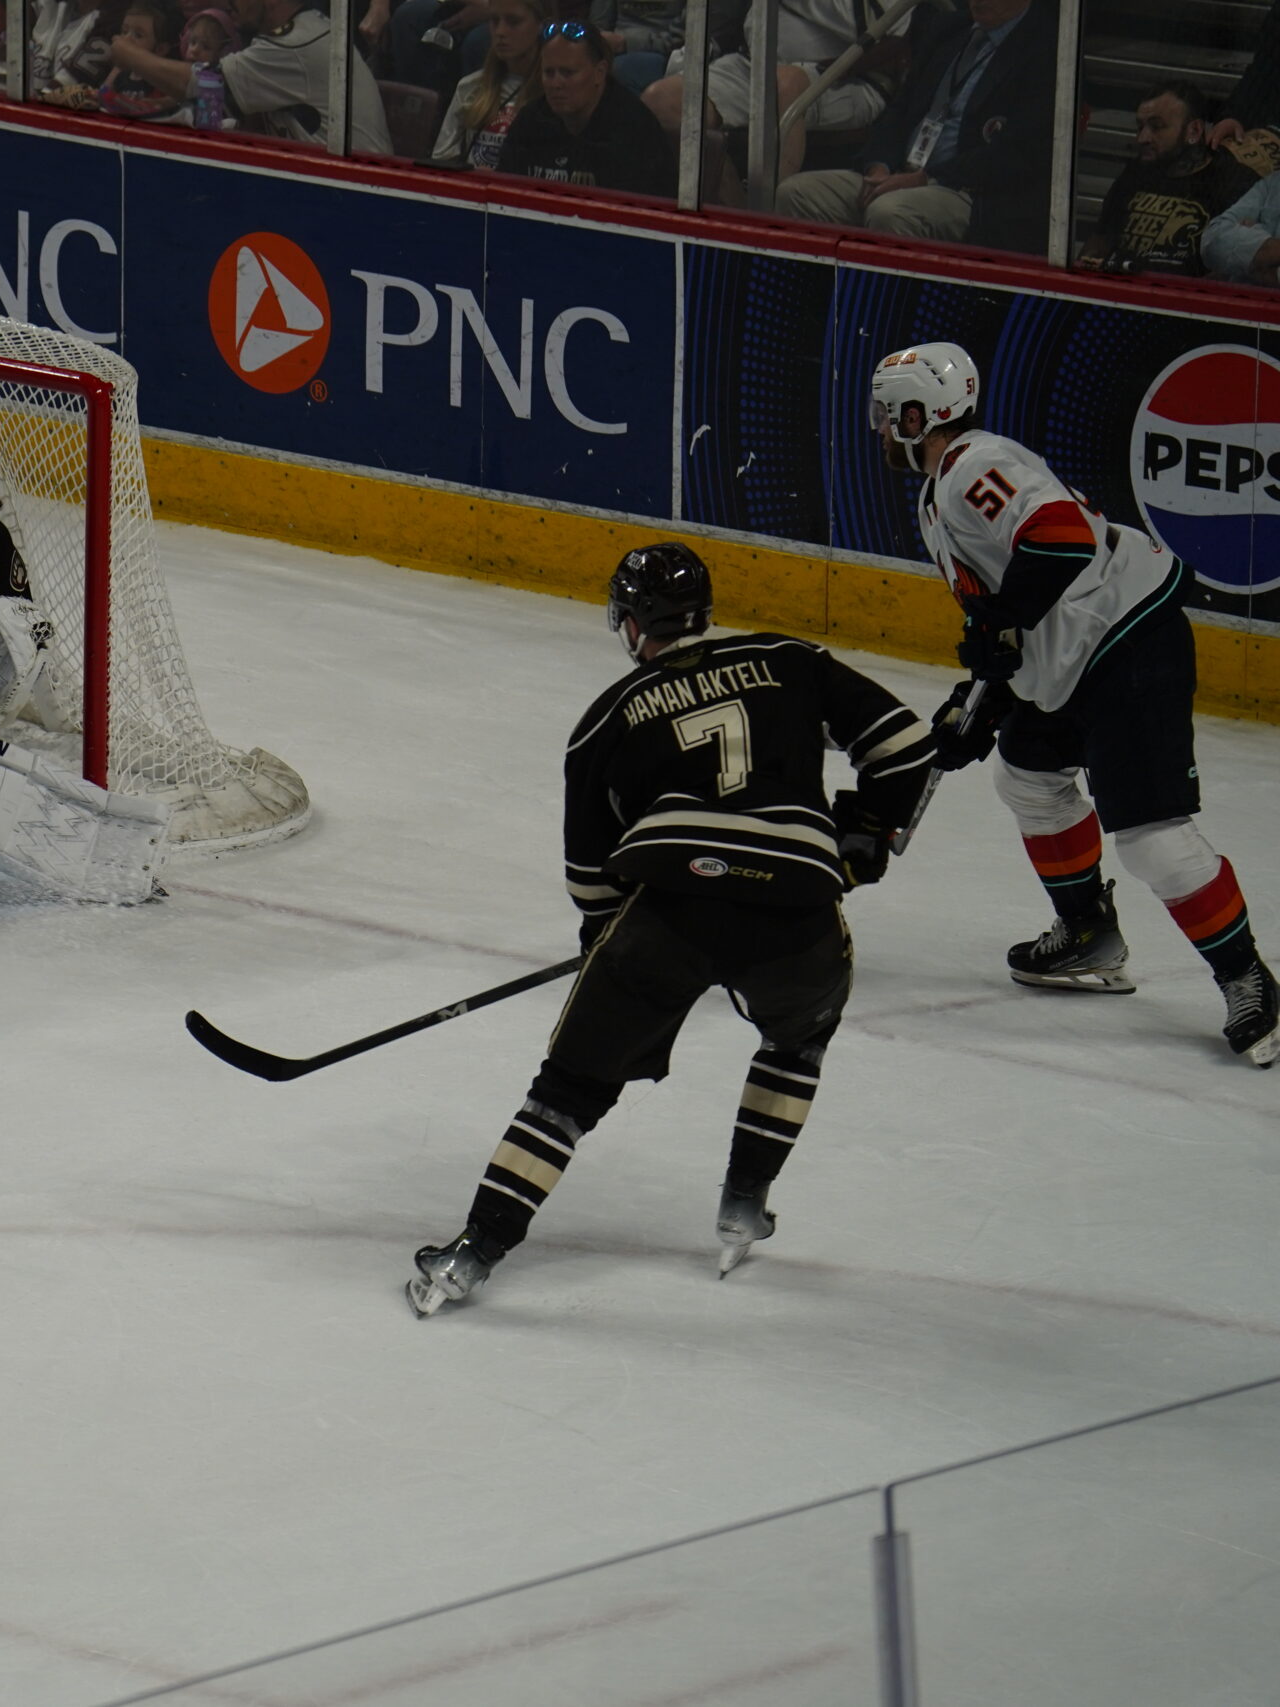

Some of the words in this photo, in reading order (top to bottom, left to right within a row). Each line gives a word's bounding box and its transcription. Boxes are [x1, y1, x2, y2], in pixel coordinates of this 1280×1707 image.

[1124, 212, 1165, 236] THE
[350, 268, 631, 435] PNC
[964, 468, 1017, 521] 51
[623, 676, 698, 730] HAMAN
[695, 660, 783, 702] AKTELL
[671, 698, 753, 799] 7
[728, 864, 774, 882] CCM
